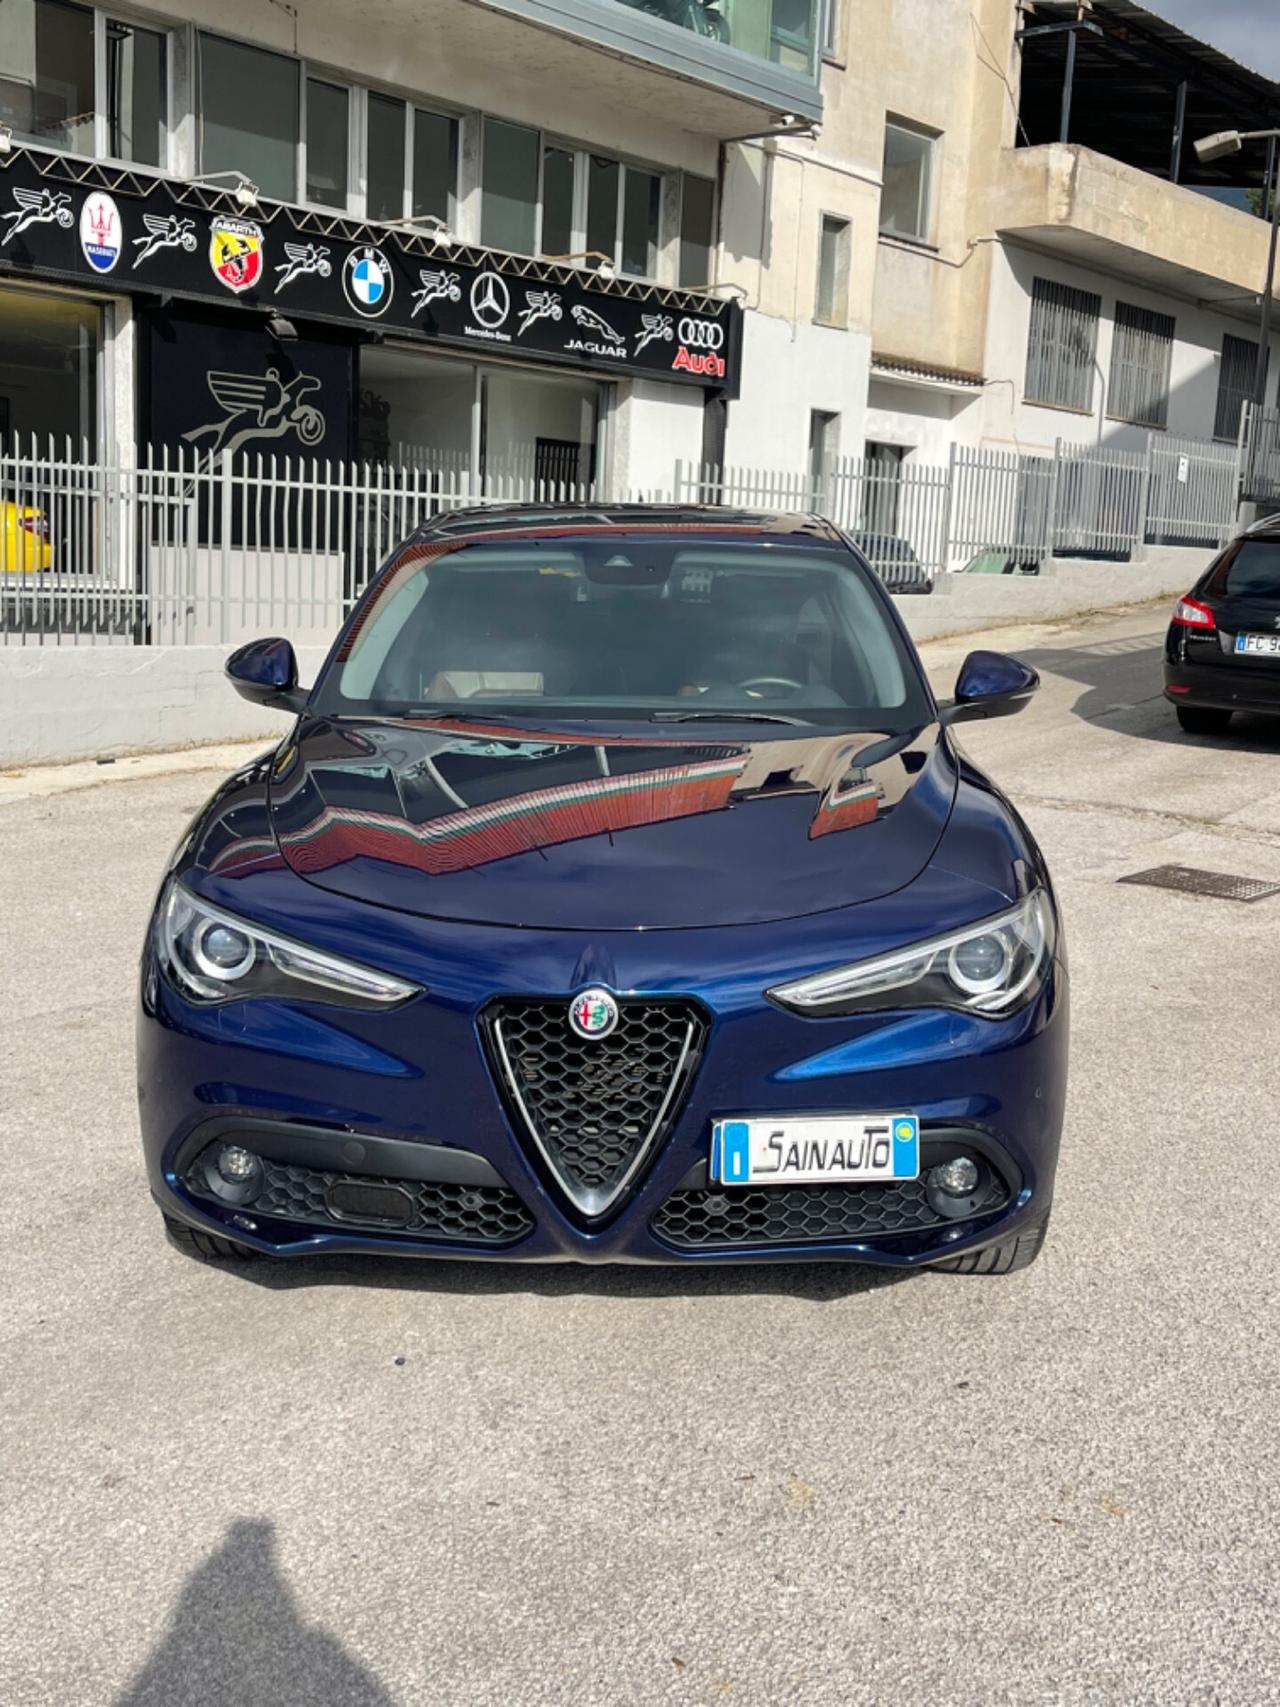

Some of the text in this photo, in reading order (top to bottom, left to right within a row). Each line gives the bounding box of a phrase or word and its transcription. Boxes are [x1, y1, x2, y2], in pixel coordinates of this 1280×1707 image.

[215, 219, 260, 237] ABARTH
[348, 248, 390, 274] BMW
[464, 325, 512, 342] Mercedes-Benz
[563, 338, 628, 358] JAGUAR
[671, 345, 726, 378] Audi
[1247, 634, 1280, 651] FC 9
